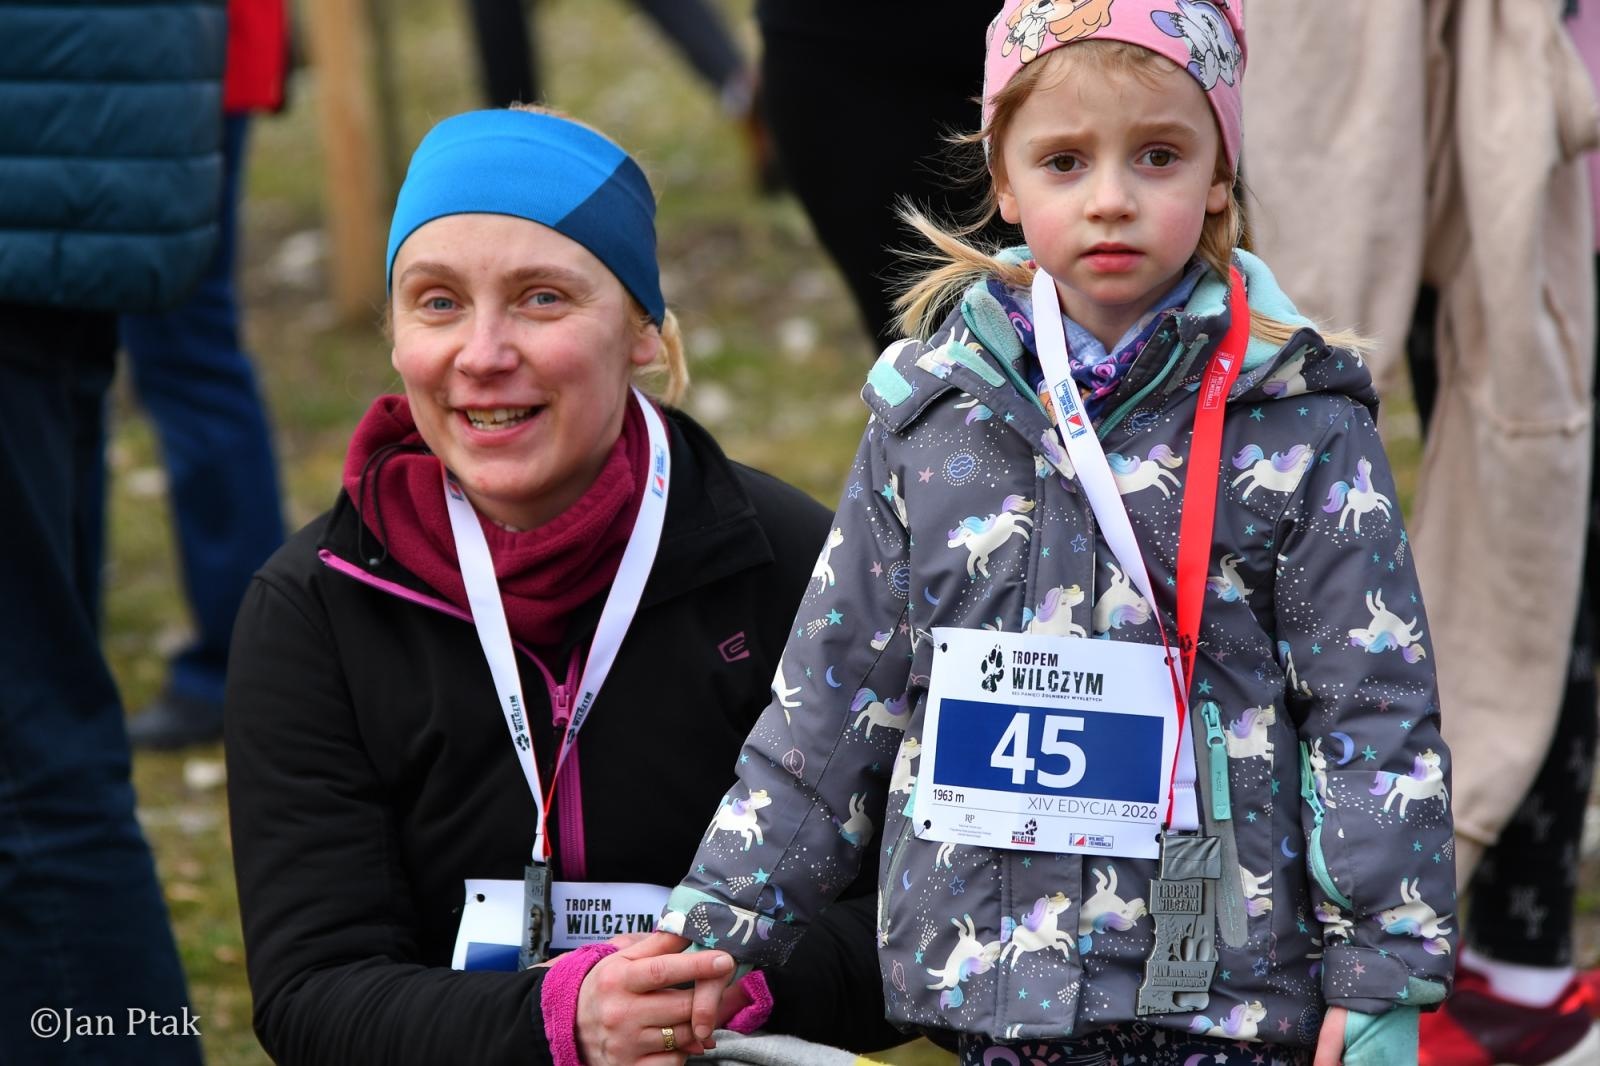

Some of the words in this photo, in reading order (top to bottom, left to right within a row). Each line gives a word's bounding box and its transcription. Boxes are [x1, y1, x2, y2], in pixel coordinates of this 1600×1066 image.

[1012, 650, 1059, 667] TROPEM
[1012, 666, 1104, 696] WILCZYM
[509, 695, 524, 732] WILCZYM
[990, 712, 1087, 789] 45
[933, 788, 954, 802] 1963
[955, 793, 965, 803] m
[1027, 797, 1054, 812] XIV
[1058, 799, 1117, 816] EDYCJA
[1121, 804, 1157, 820] 2026
[1157, 884, 1199, 898] TROPEM
[566, 898, 612, 912] TROPEM
[1157, 898, 1199, 912] WILCZYM
[566, 913, 654, 935] WILCZYM
